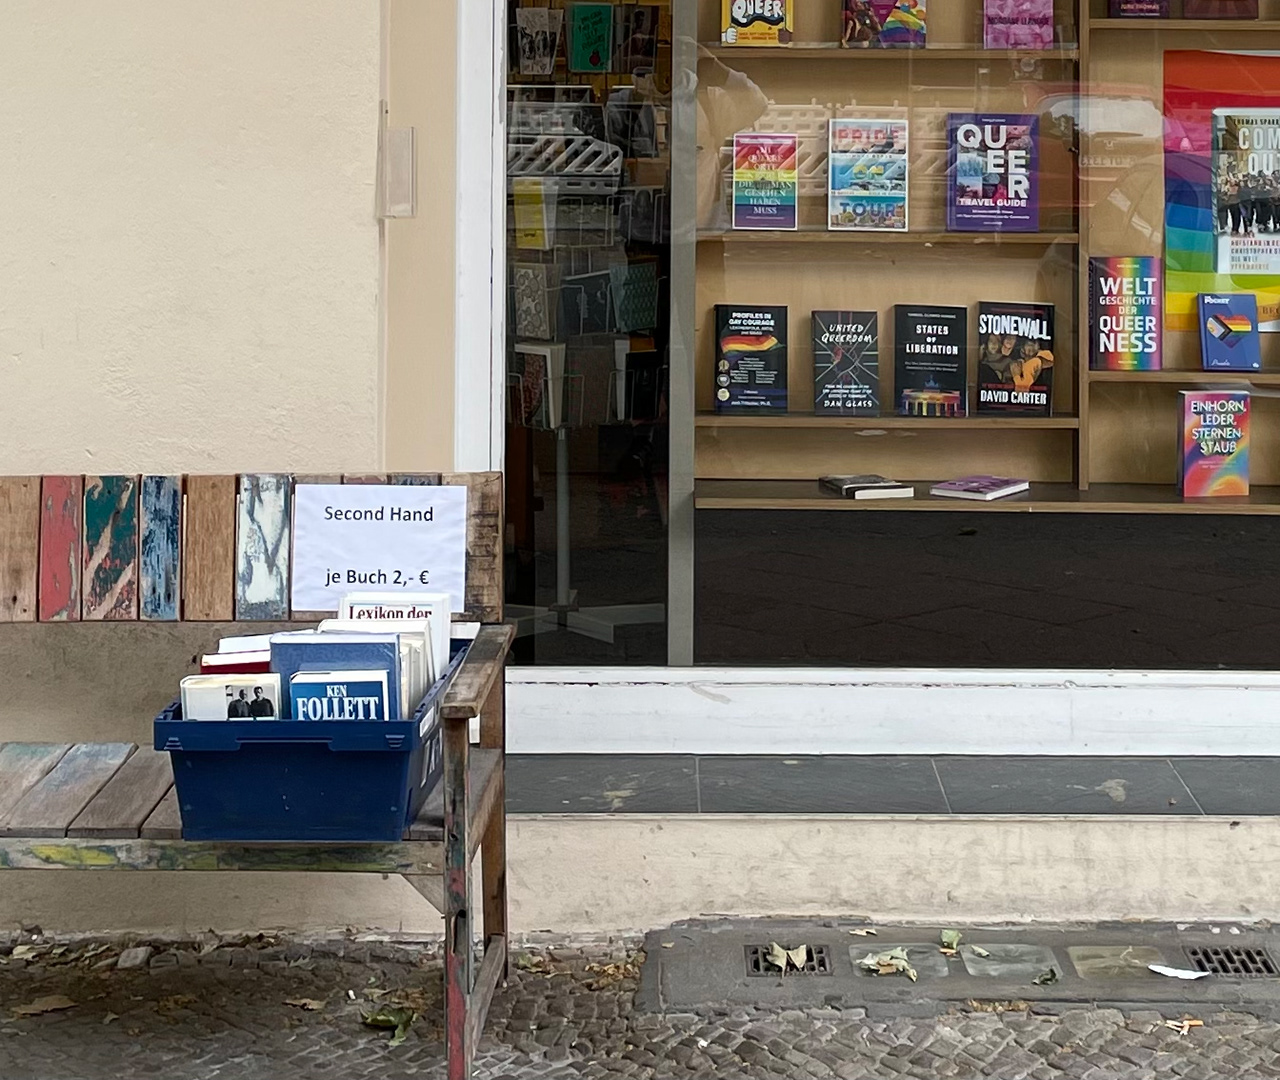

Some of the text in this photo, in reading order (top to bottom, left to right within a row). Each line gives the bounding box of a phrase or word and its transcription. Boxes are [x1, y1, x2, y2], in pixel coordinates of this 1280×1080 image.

[957, 123, 1006, 149] QU
[753, 206, 777, 214] MUSS
[840, 202, 896, 217] TOUR
[997, 199, 1026, 207] GUIDE
[1100, 277, 1157, 295] WELT
[1100, 296, 1157, 305] GESCHICHTE
[1118, 306, 1137, 314] DER
[829, 324, 863, 332] UNITED
[916, 324, 949, 335] STATES
[979, 314, 1051, 340] STONEWALL
[1100, 316, 1156, 333] QUEER
[822, 332, 872, 343] QUEERDOM
[1100, 333, 1157, 352] NESS
[906, 344, 958, 355] LIBERATION
[980, 390, 1047, 405] DAVID CARTER
[1200, 441, 1237, 453] STAUB
[325, 506, 433, 522] Second Hand
[325, 569, 429, 587] je Buch 2,- €
[349, 605, 404, 619] Lexikon
[326, 685, 347, 697] KEN
[297, 697, 379, 720] FOLLETT
